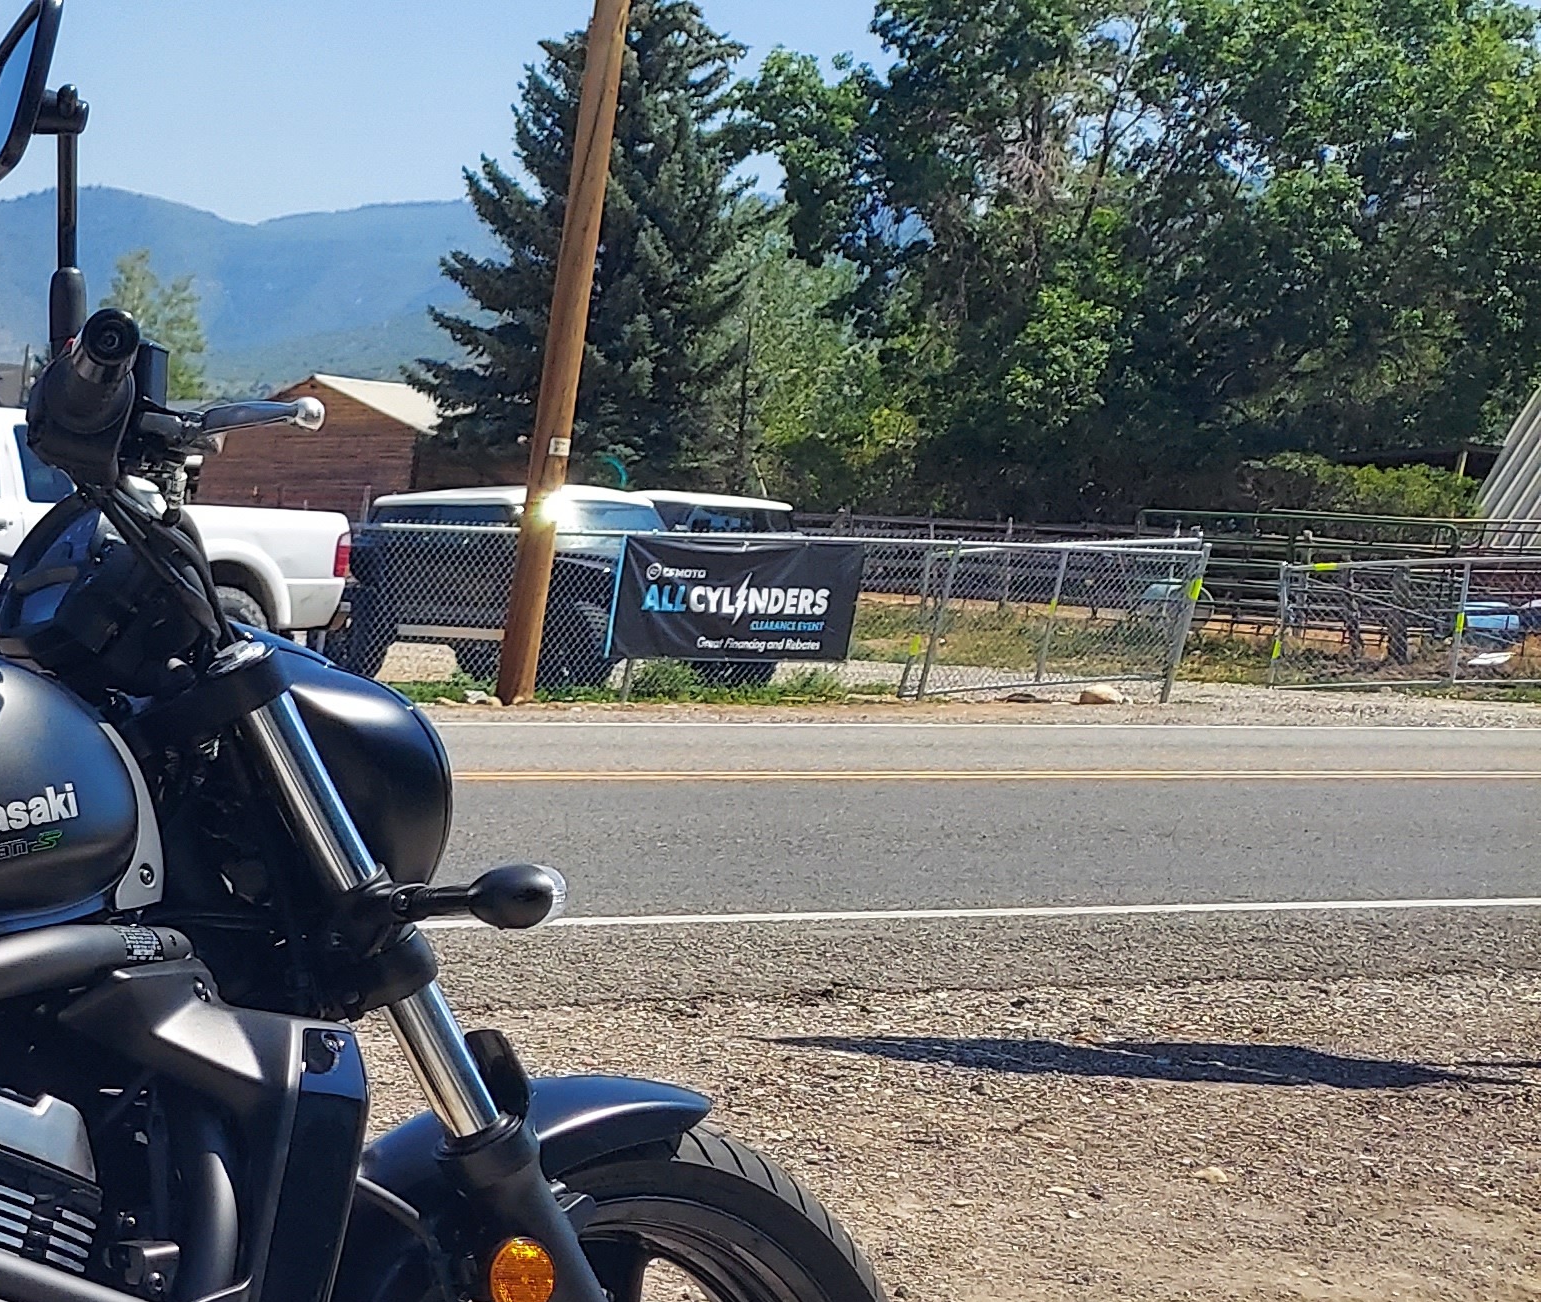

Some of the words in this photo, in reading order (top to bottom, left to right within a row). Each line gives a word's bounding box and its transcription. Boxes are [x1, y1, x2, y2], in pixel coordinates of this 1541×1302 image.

[641, 583, 689, 612] ALL
[750, 620, 796, 631] CLEARANCE
[797, 621, 825, 632] EVENT
[724, 637, 766, 652] Financing
[766, 639, 783, 650] and
[784, 638, 820, 650] Rebates
